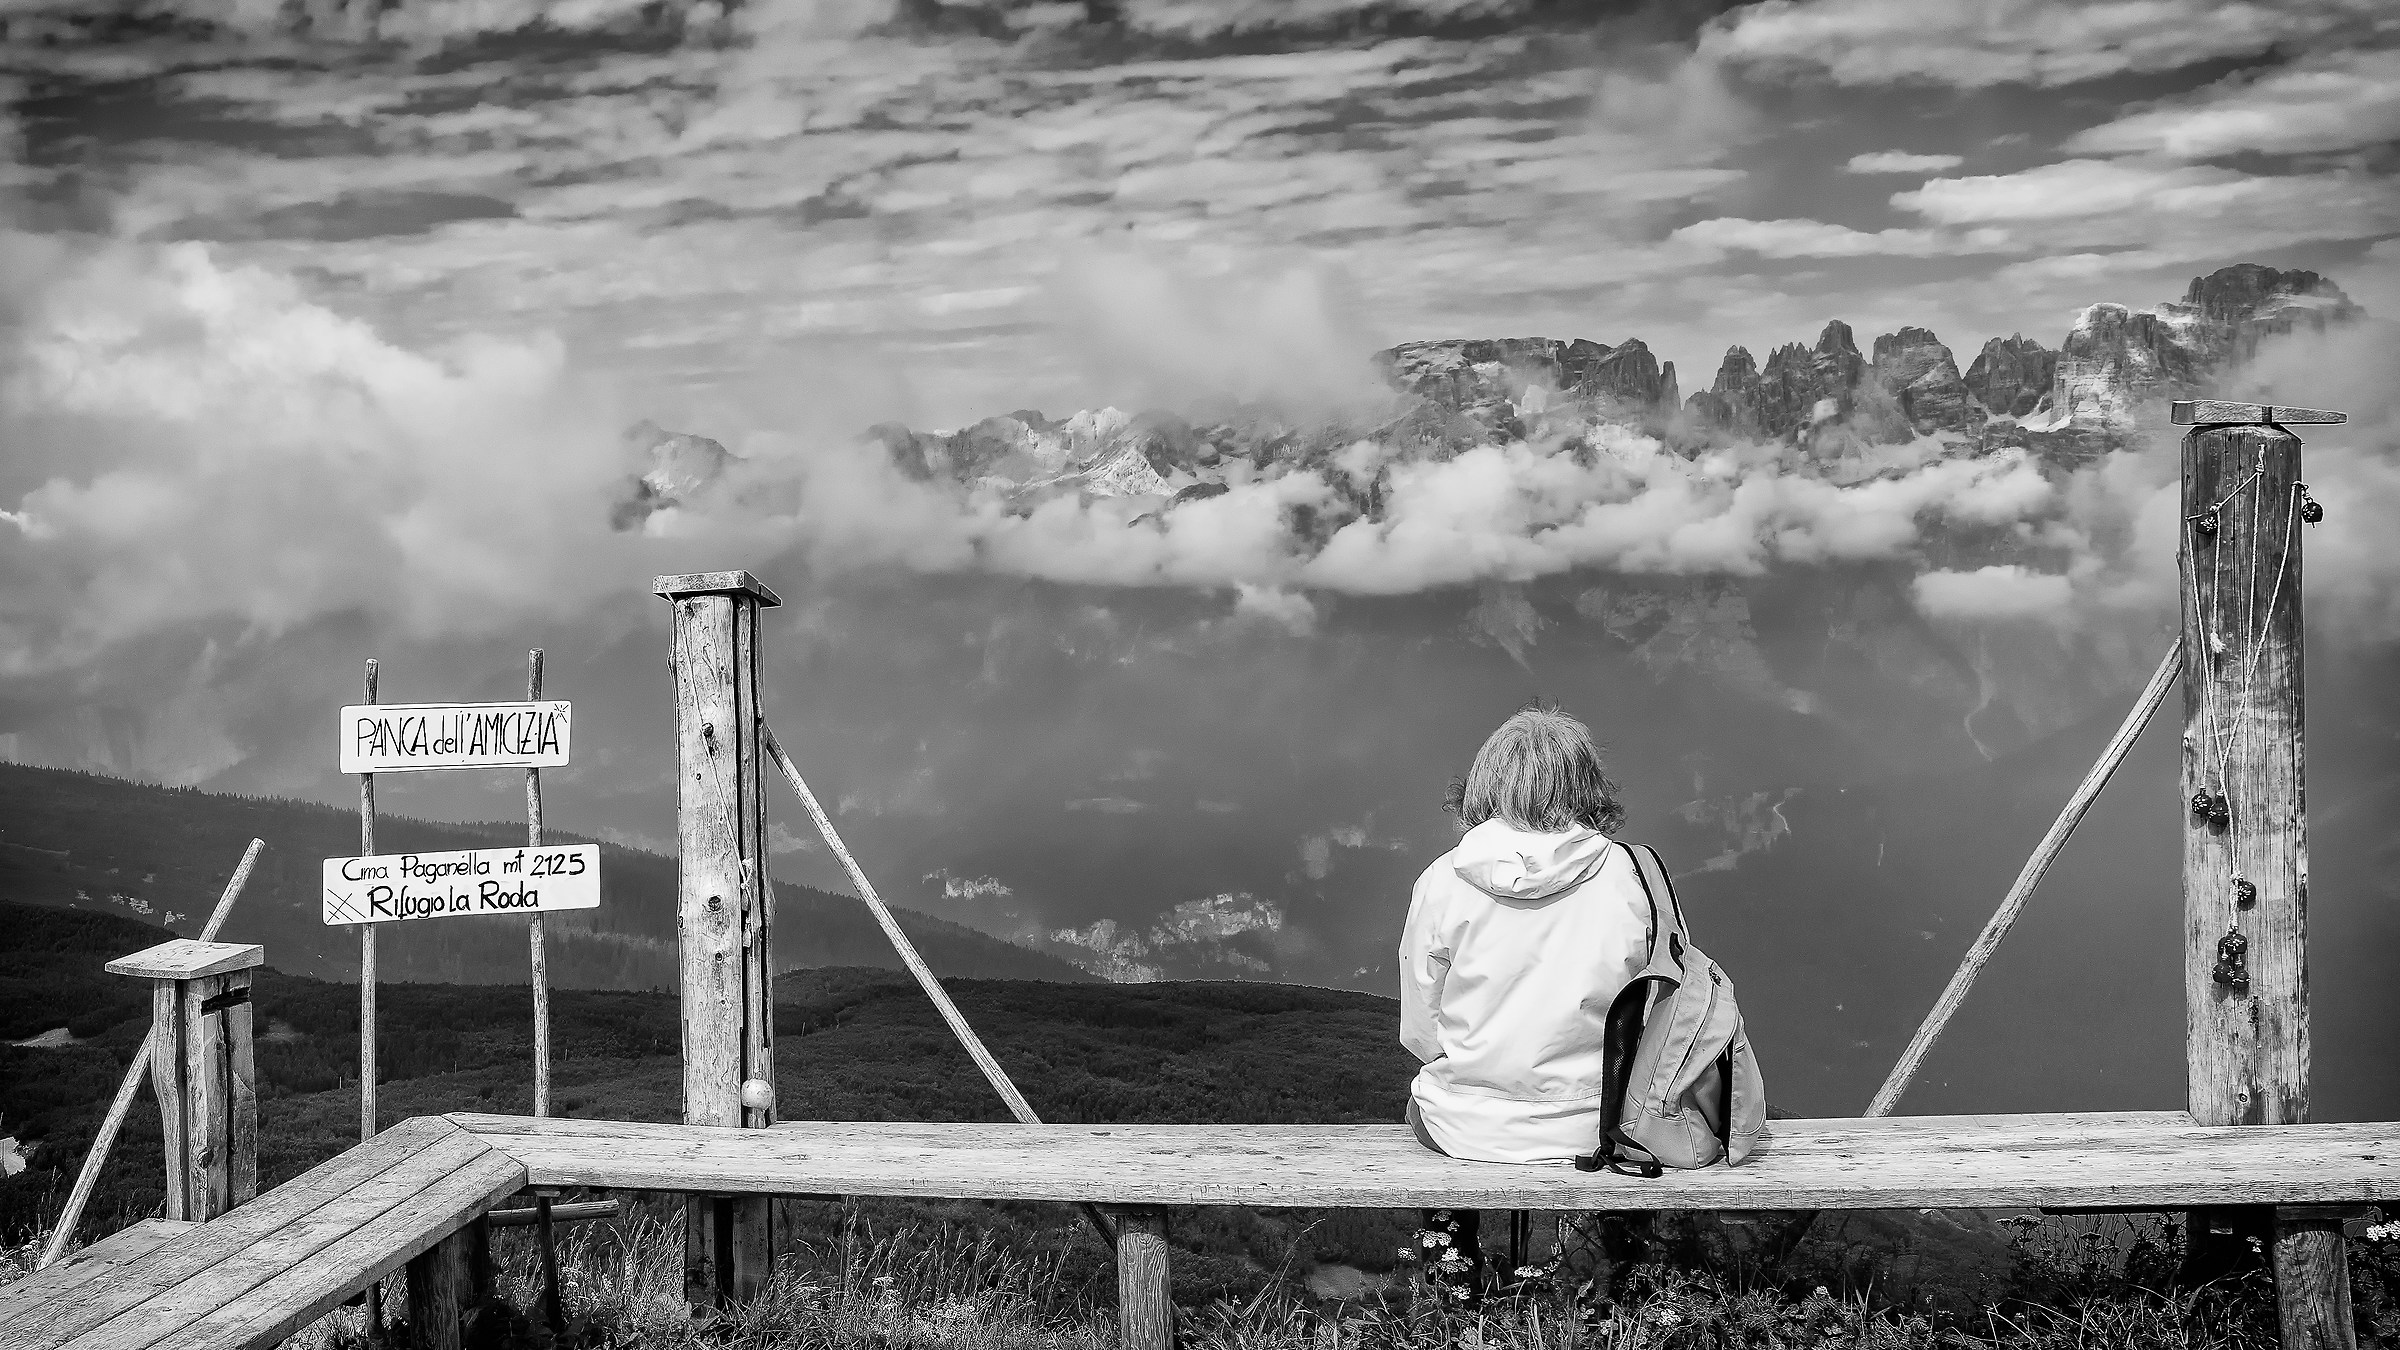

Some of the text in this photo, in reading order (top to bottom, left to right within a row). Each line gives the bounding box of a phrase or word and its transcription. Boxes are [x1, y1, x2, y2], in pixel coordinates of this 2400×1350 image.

[357, 715, 429, 757] PANCA
[341, 859, 388, 881] Cima
[503, 850, 524, 875] mt
[530, 853, 586, 878] 2125
[367, 886, 445, 919] Rifugio
[478, 880, 538, 910] Roda
